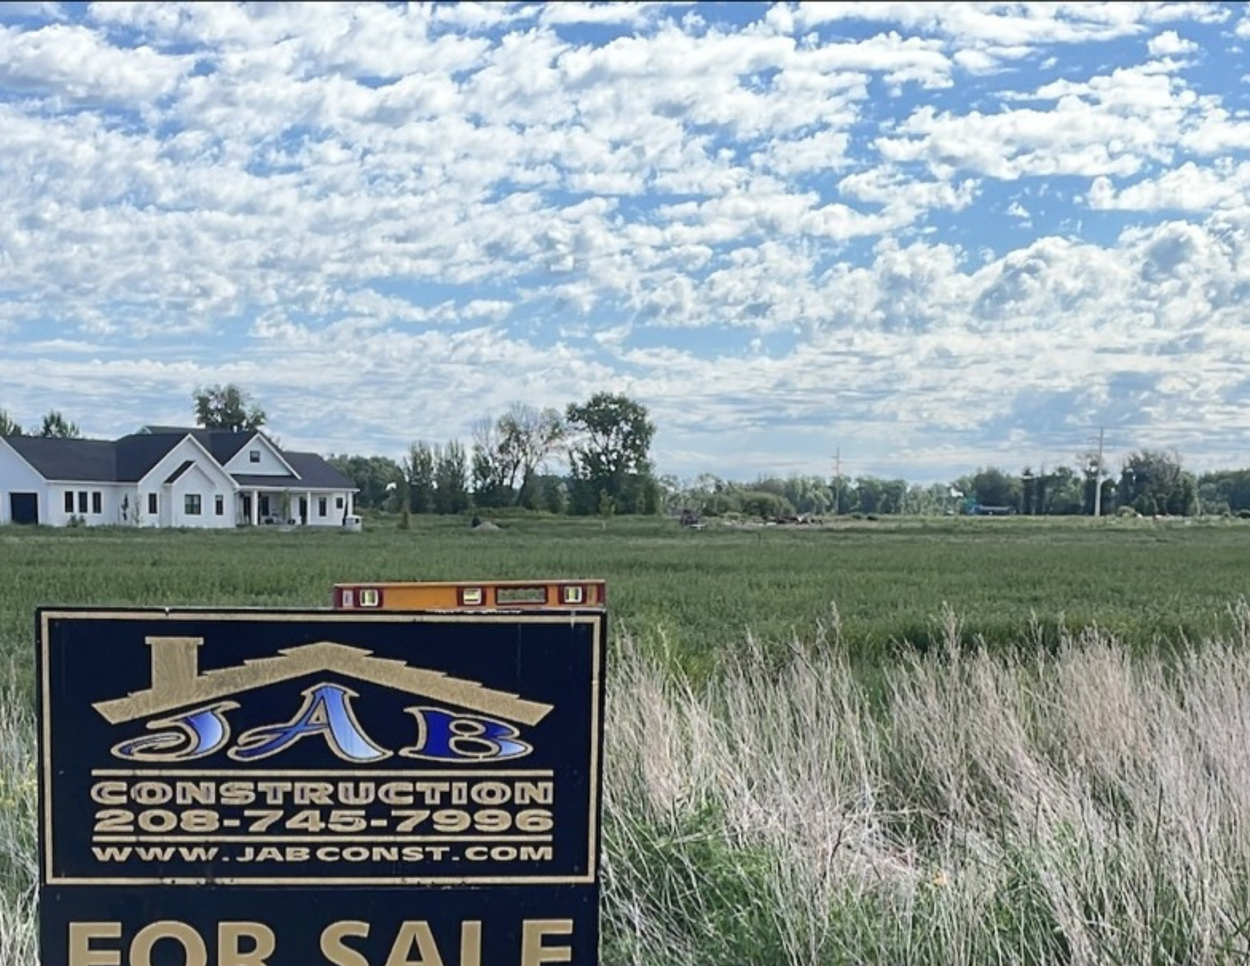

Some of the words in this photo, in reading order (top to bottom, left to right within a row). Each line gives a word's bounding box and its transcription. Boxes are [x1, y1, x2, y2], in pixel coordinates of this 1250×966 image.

[110, 682, 535, 763] JAB
[90, 781, 554, 806] CONSTRUCTION
[94, 809, 554, 833] 208-745-7996
[91, 846, 553, 862] WWW.JABCONST.COM
